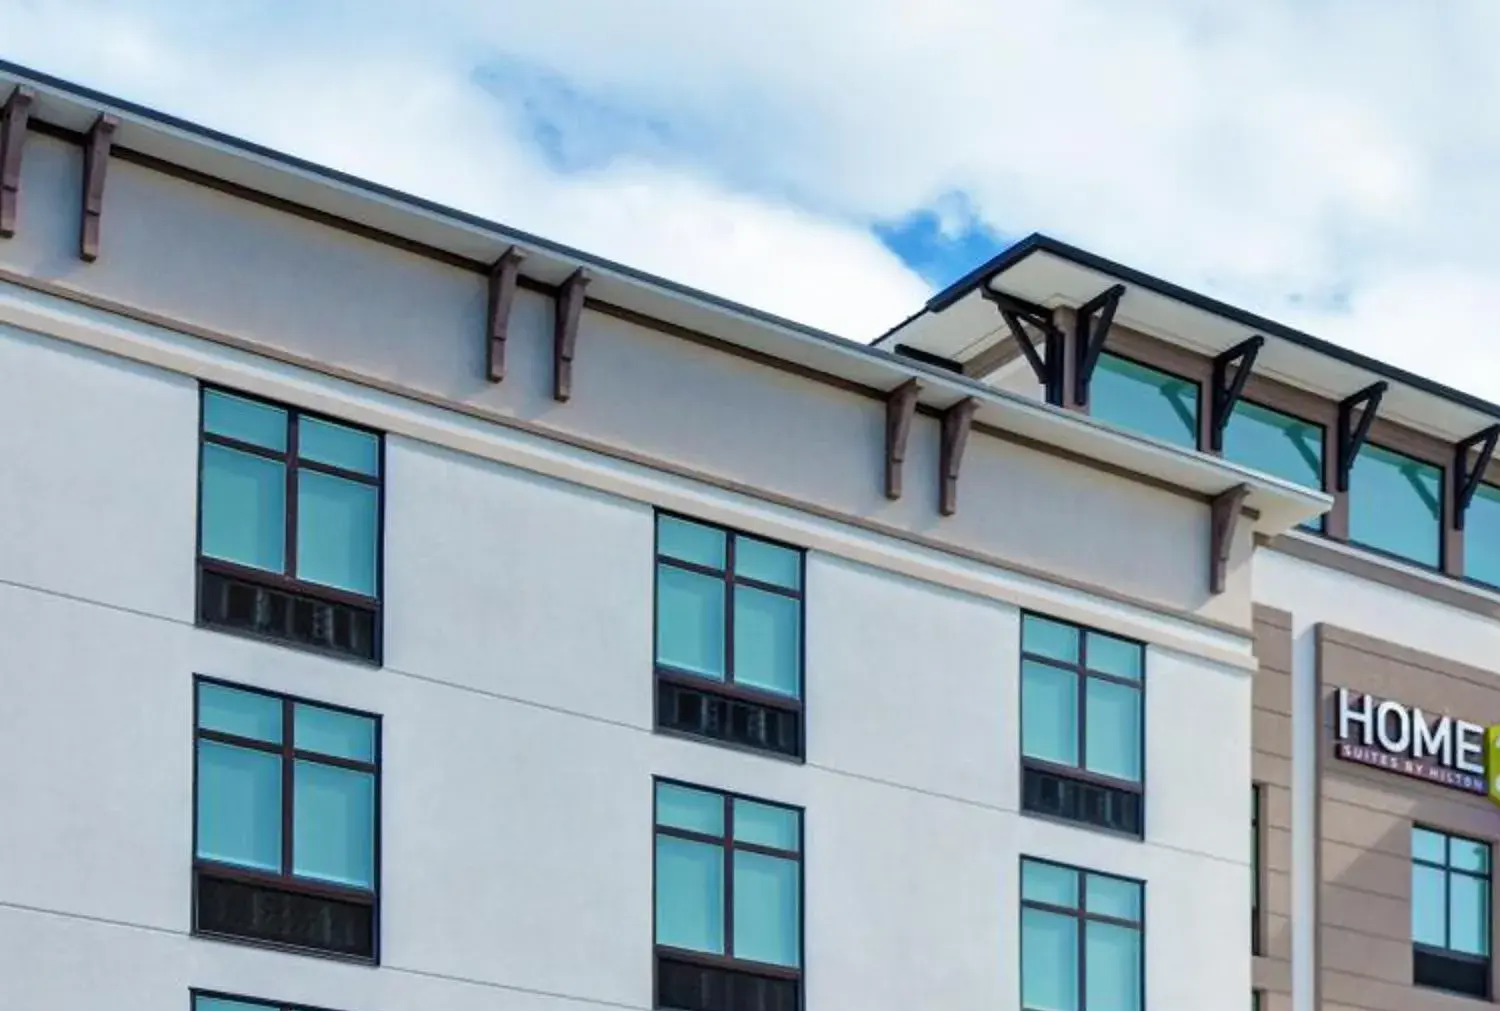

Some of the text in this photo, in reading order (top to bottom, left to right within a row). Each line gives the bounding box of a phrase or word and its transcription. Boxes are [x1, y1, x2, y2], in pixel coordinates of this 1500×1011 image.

[1338, 687, 1484, 773] HOME
[1342, 745, 1484, 791] SUITES BY HILTON
